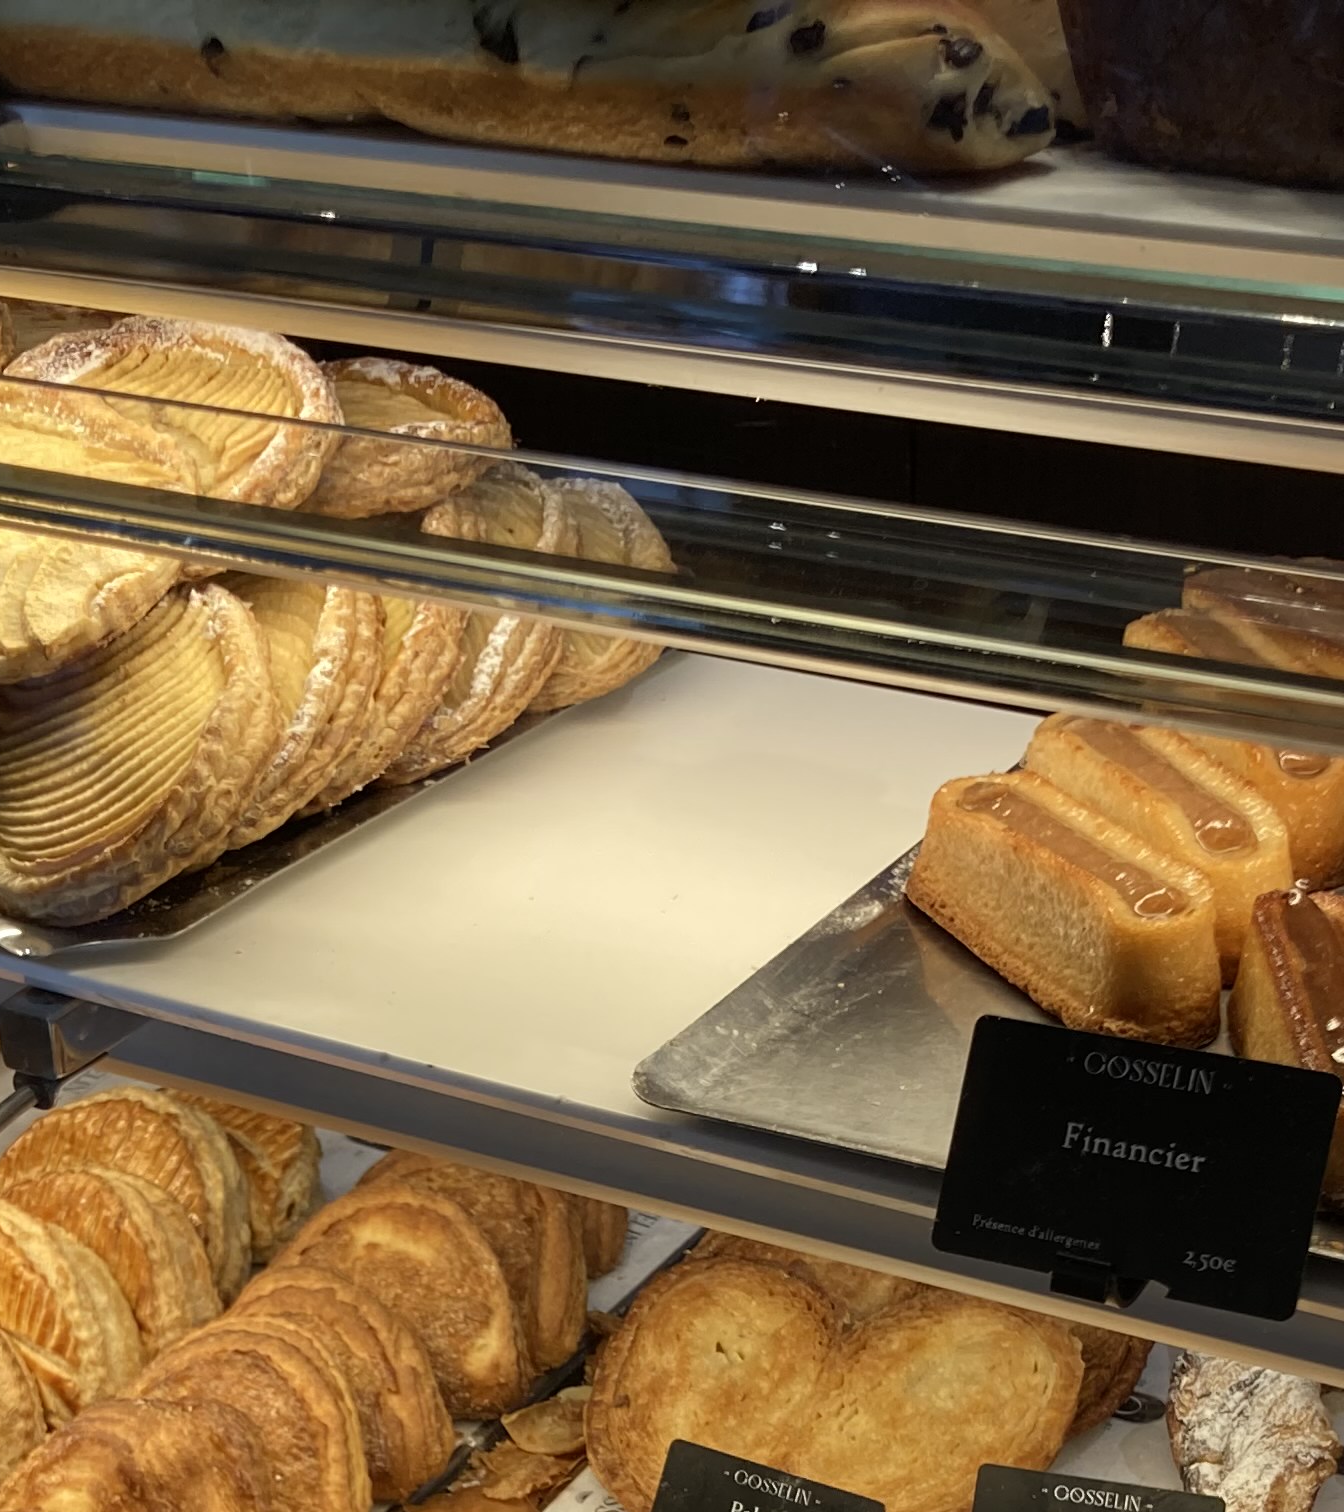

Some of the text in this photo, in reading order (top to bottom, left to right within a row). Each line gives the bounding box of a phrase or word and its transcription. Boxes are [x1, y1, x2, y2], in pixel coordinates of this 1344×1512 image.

[1083, 1051, 1216, 1096] GOSSELIN
[1061, 1121, 1206, 1174] Financier
[971, 1214, 1025, 1237] Présence
[734, 1469, 813, 1507] GOSSELIN
[1053, 1484, 1142, 1512] GOSSELIN
